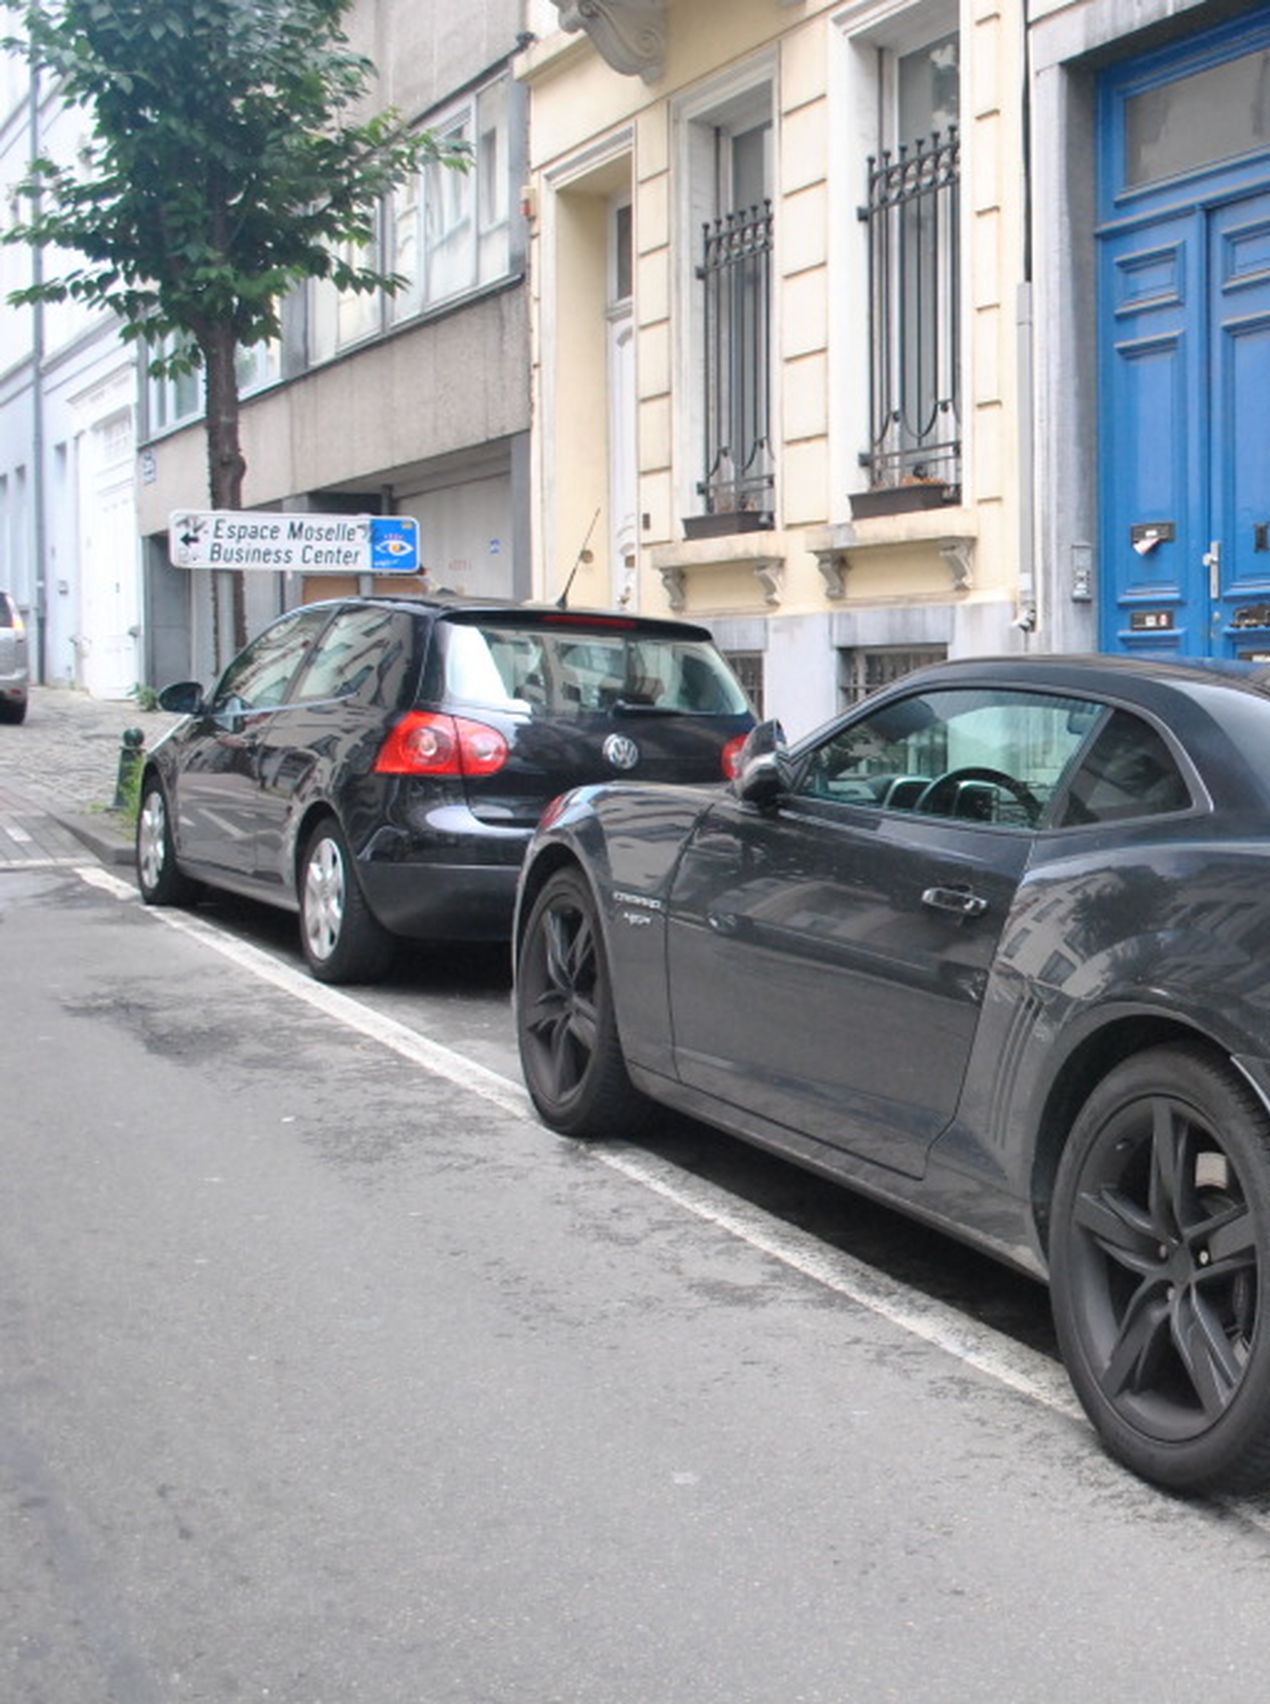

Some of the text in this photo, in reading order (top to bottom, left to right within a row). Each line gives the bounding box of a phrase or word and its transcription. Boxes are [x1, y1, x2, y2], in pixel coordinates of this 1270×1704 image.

[212, 519, 357, 544] Espace Moselle
[209, 545, 293, 564] Business
[301, 547, 362, 565] Center
